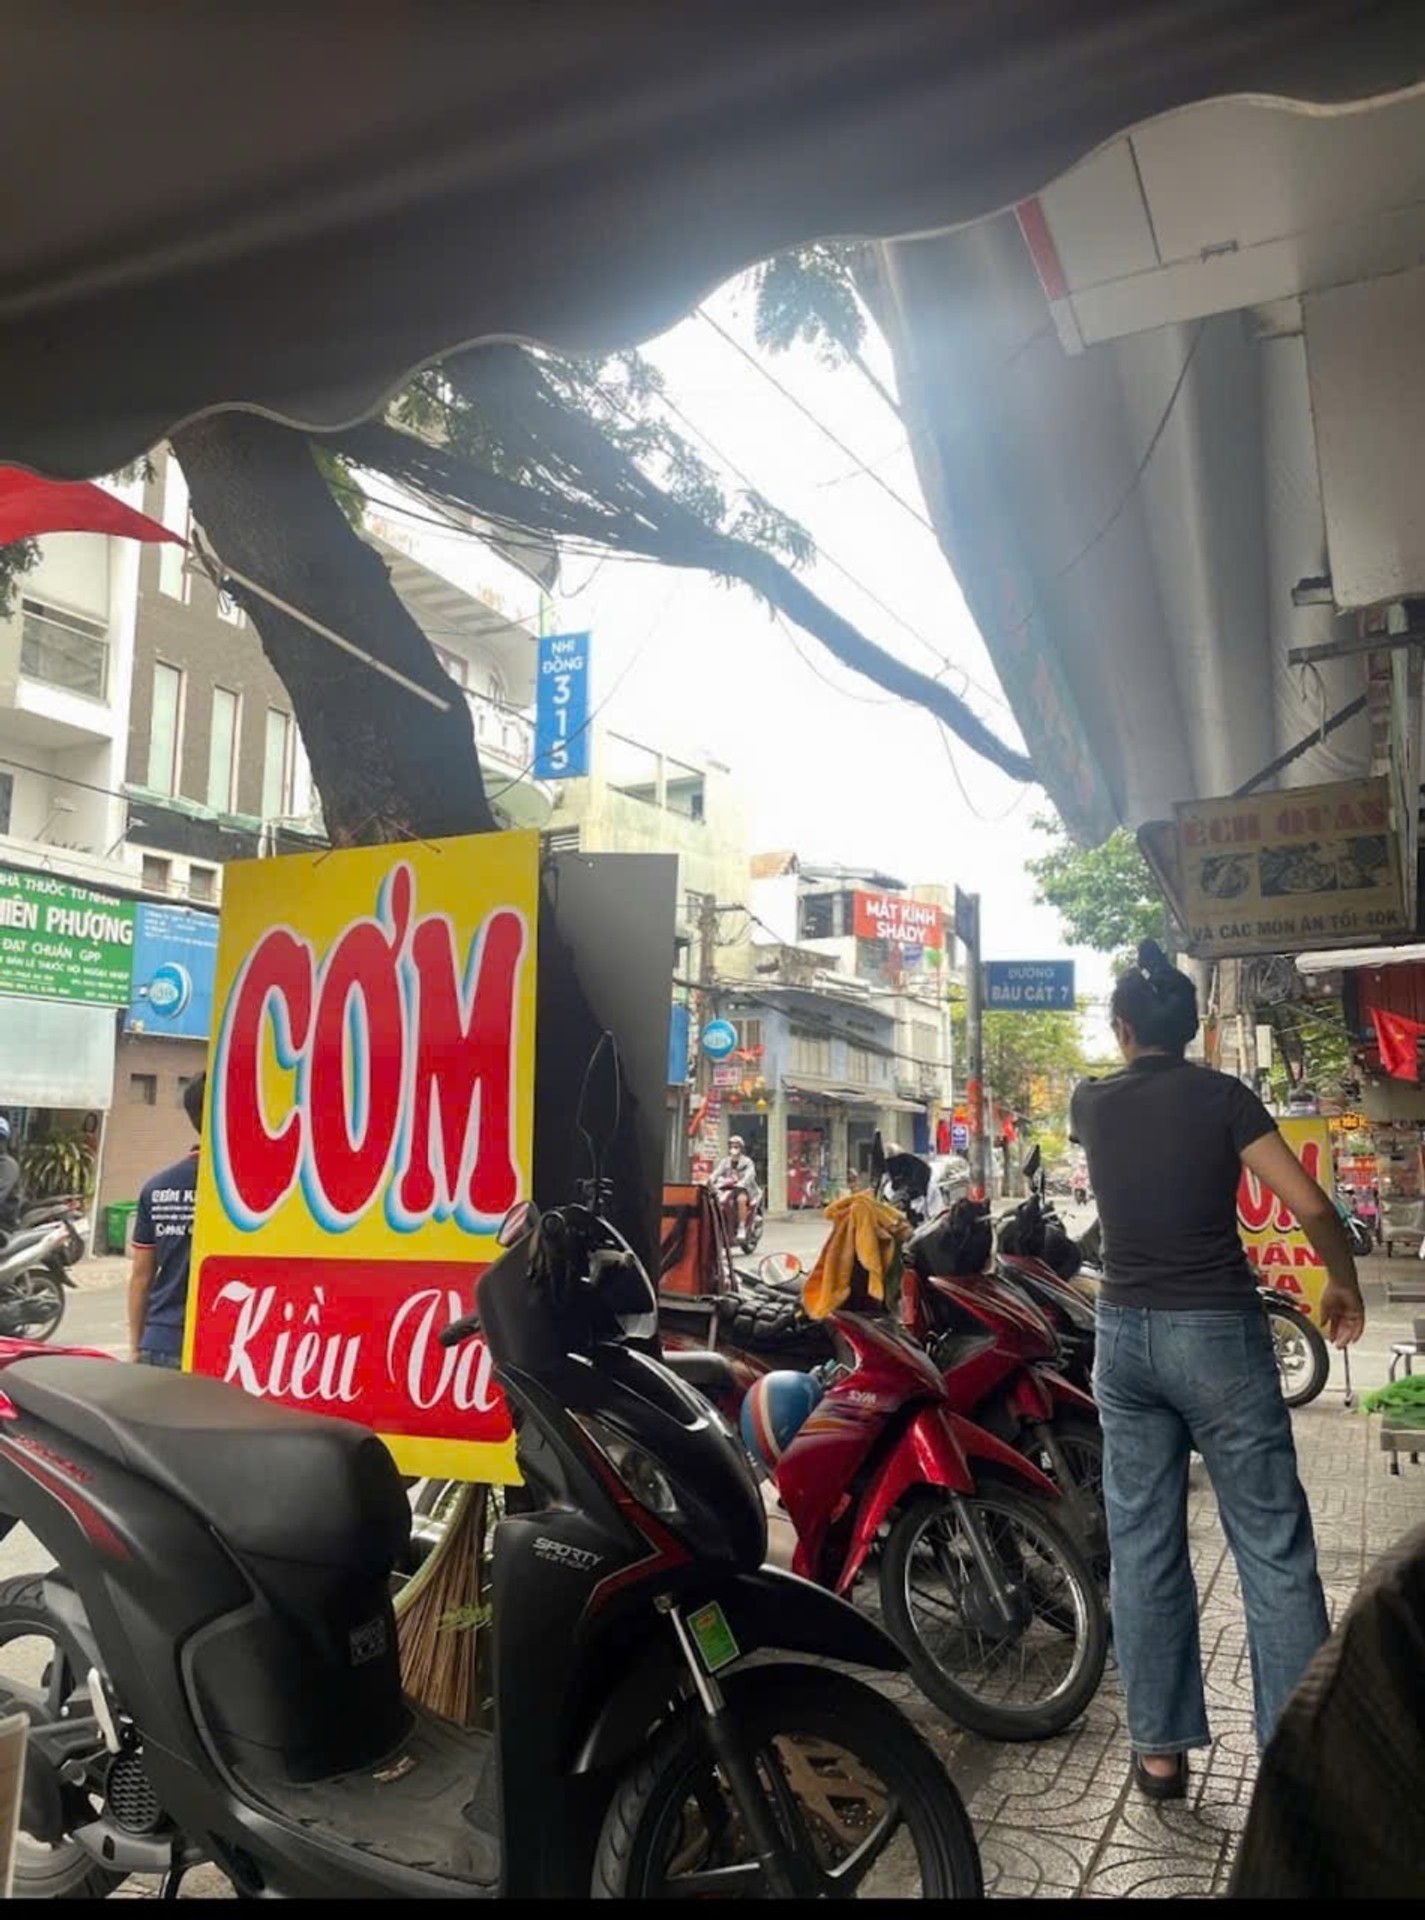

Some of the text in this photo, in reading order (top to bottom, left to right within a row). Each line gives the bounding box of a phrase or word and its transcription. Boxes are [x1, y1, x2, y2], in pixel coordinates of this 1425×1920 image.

[552, 640, 575, 655] NHI
[542, 654, 584, 674] ĐỒNG
[551, 674, 571, 770] 315
[46, 906, 133, 946] PHƯỢNG
[876, 921, 928, 944] SHADY
[79, 949, 102, 963] GPP
[214, 860, 527, 1228] CƠM
[211, 1280, 363, 1402] Kiều
[848, 1390, 877, 1404] SYM
[533, 1537, 604, 1566] SPORTY
